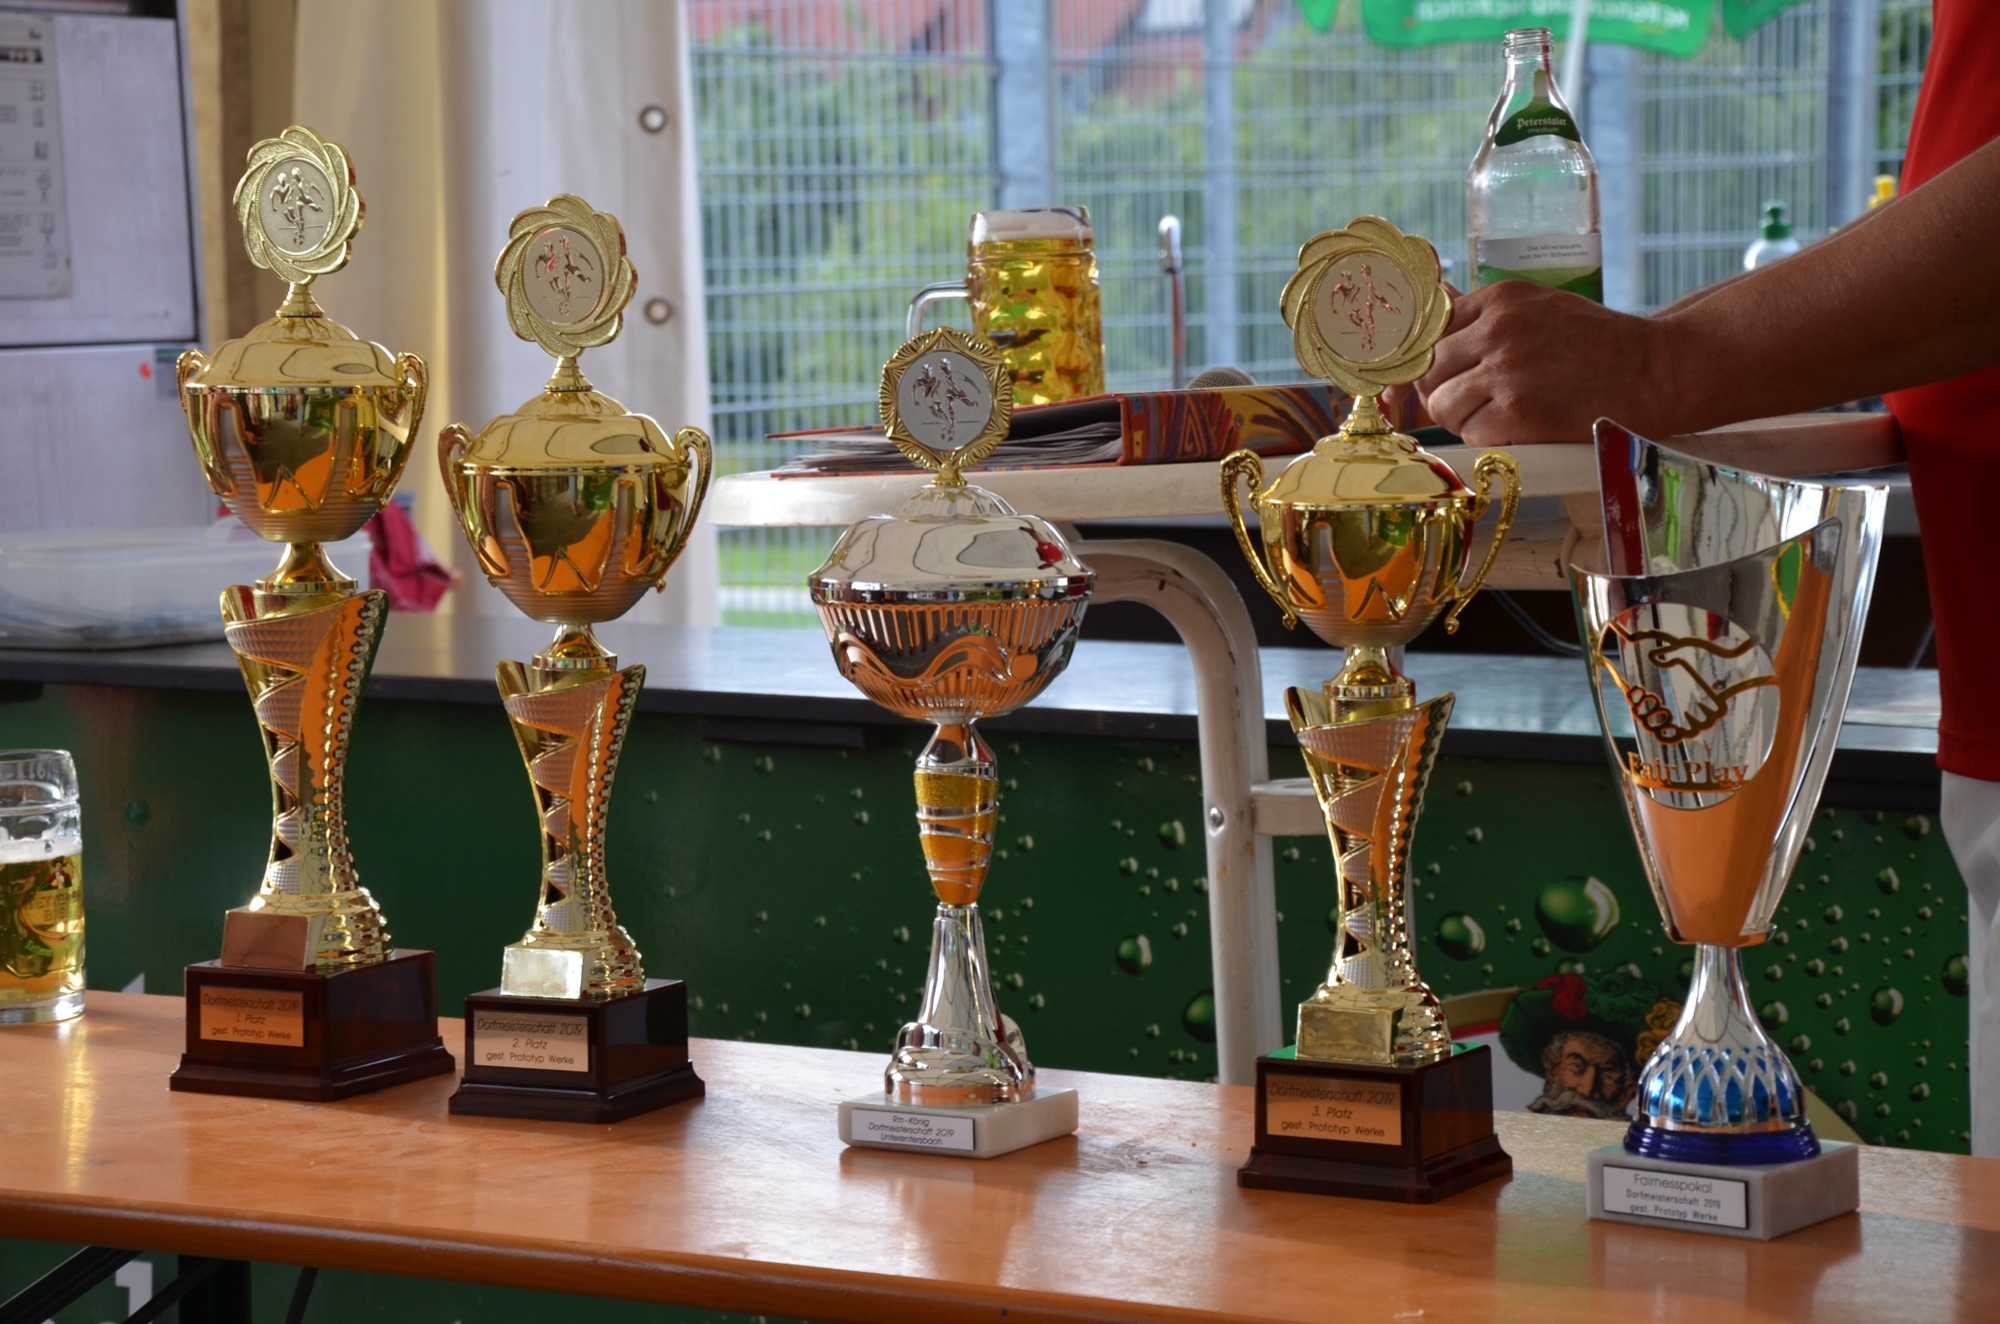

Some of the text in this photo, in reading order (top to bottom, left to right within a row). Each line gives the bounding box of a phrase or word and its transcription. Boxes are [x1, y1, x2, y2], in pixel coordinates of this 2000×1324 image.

[1628, 750, 1750, 790] Fair Play
[202, 994, 299, 1012] Dorfmeisterschaft 2019
[245, 1014, 266, 1024] Platz
[233, 1027, 264, 1038] Prototyp
[268, 1030, 292, 1040] Werke
[477, 1018, 583, 1036] Dorfmeisterschaft 2019
[512, 1037, 548, 1050] 2. Platz
[486, 1052, 575, 1065] gest. Prototyp Werke
[1270, 1083, 1395, 1105] Dorfmeisterschaft 2019
[1312, 1106, 1353, 1120] 3. Platz
[892, 1115, 930, 1127] 9m-König
[868, 1122, 954, 1137] Dorfmeisterschaft 2019
[1281, 1121, 1385, 1137] gest. Prototyp Werke
[880, 1133, 943, 1145] Unterentersbach
[1634, 1173, 1712, 1194] Fairnesspokal
[1626, 1189, 1721, 1209] Dorfmeisterschaft 2019
[1630, 1204, 1718, 1222] gest. Prototyp Werke
